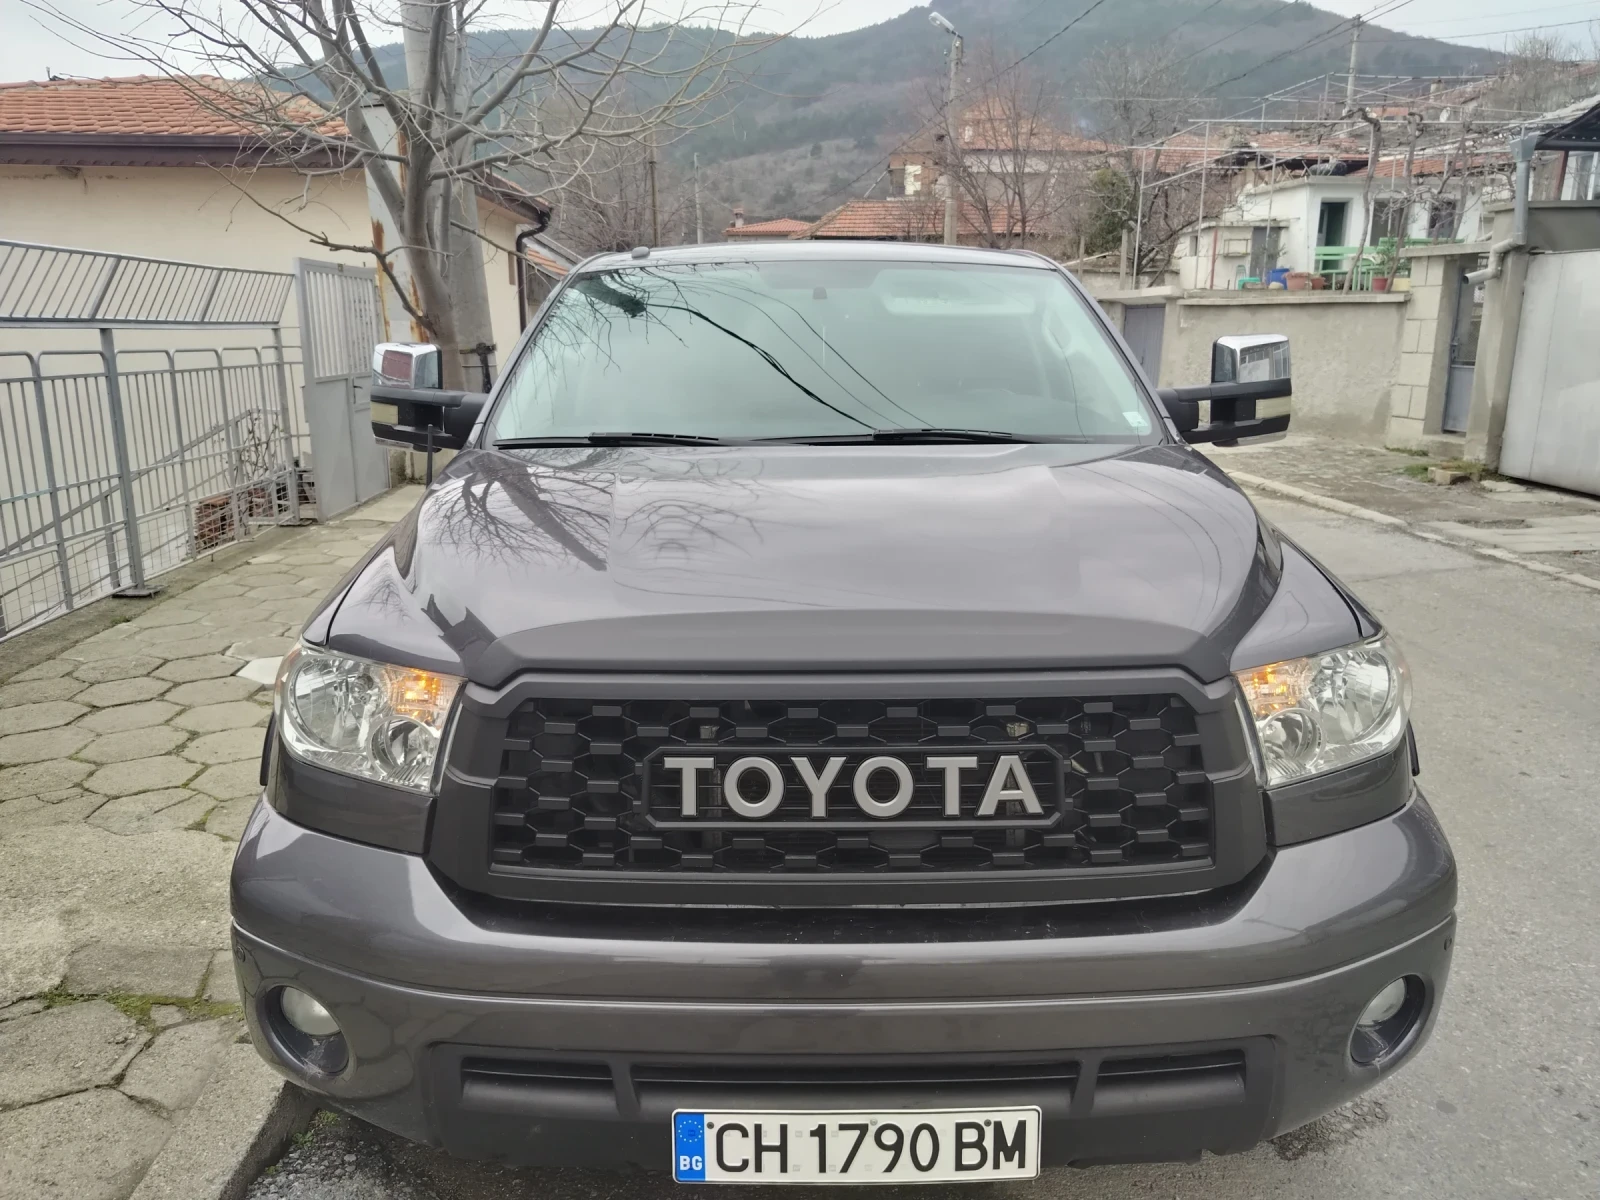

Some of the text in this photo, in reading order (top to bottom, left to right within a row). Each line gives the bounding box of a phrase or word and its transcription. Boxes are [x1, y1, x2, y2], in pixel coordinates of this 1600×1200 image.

[663, 755, 1044, 818] TOYOTA
[679, 1155, 703, 1171] BG
[715, 1119, 1027, 1174] CH 1790 BM
